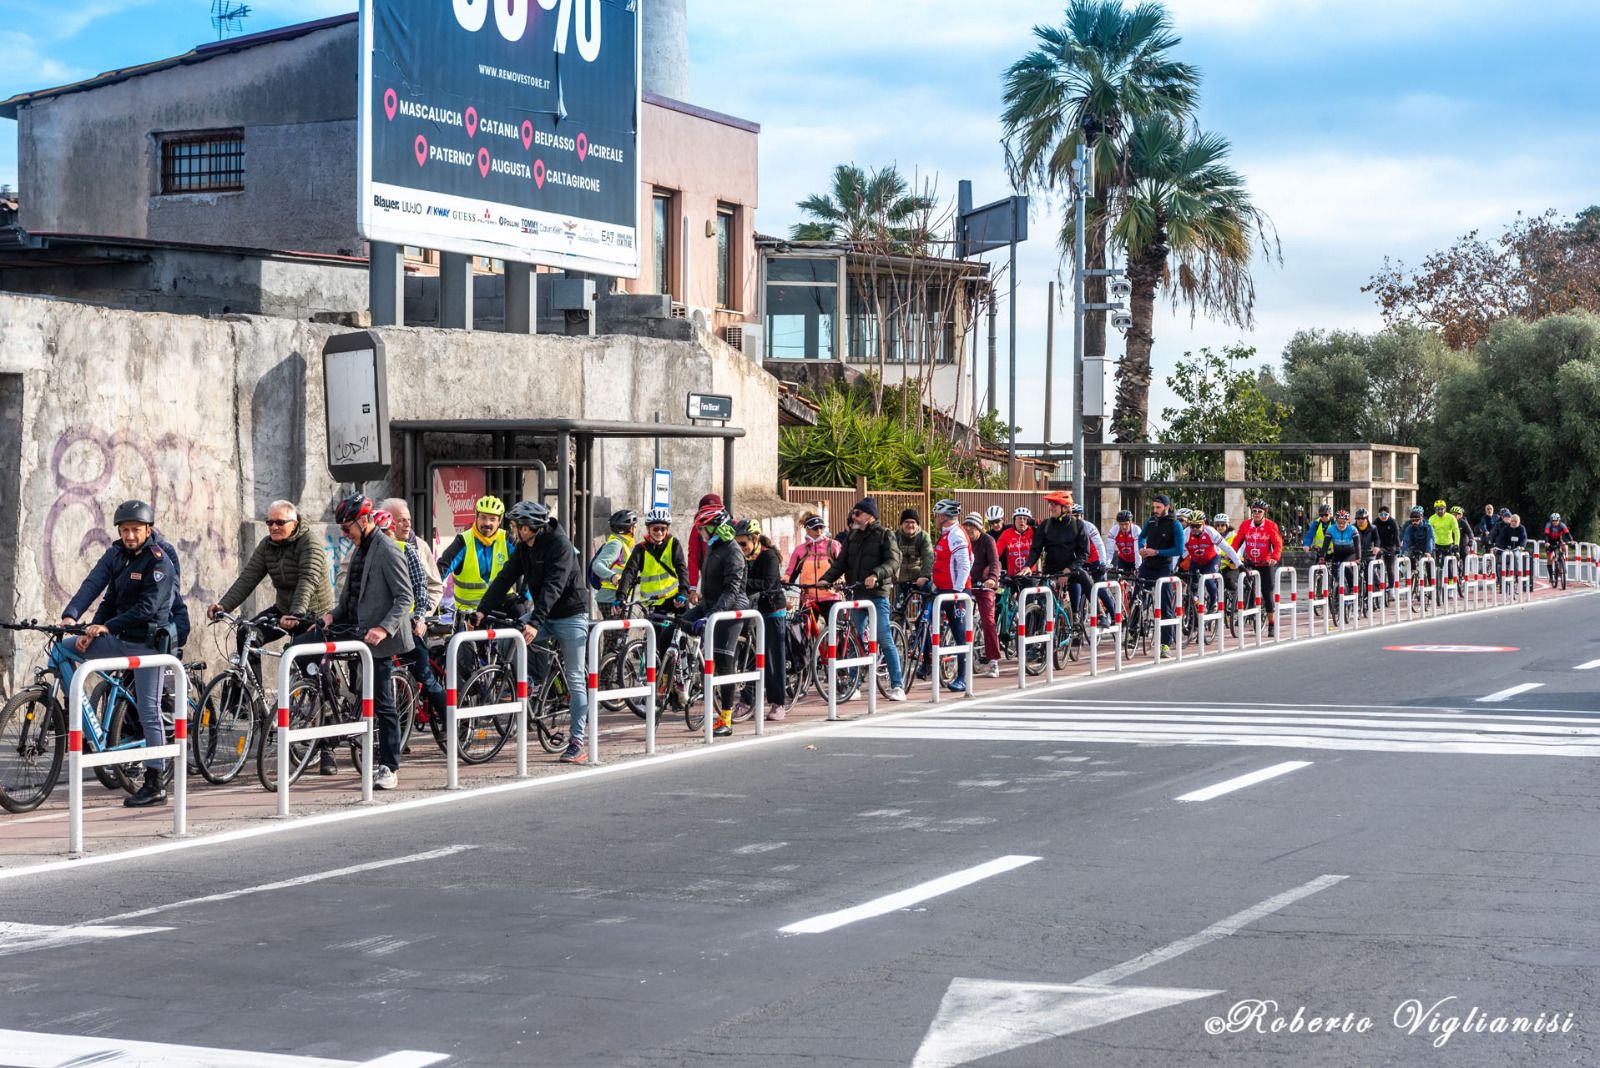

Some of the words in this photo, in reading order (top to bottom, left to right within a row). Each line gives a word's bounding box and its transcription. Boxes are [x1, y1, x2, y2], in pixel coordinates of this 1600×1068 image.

[478, 64, 551, 89] WWW.REMOVESTORE.IT
[400, 100, 462, 127] MASCALUCIA
[480, 118, 519, 139] CATANIA
[535, 130, 575, 152] BELPASSO
[588, 143, 624, 163] ACIREALE
[491, 159, 531, 179] AUGUSTA
[546, 169, 600, 193] CALTAGIRONE
[452, 210, 476, 223] GUESS
[521, 218, 539, 229] TOMMY
[82, 690, 103, 739] OLIZIA
